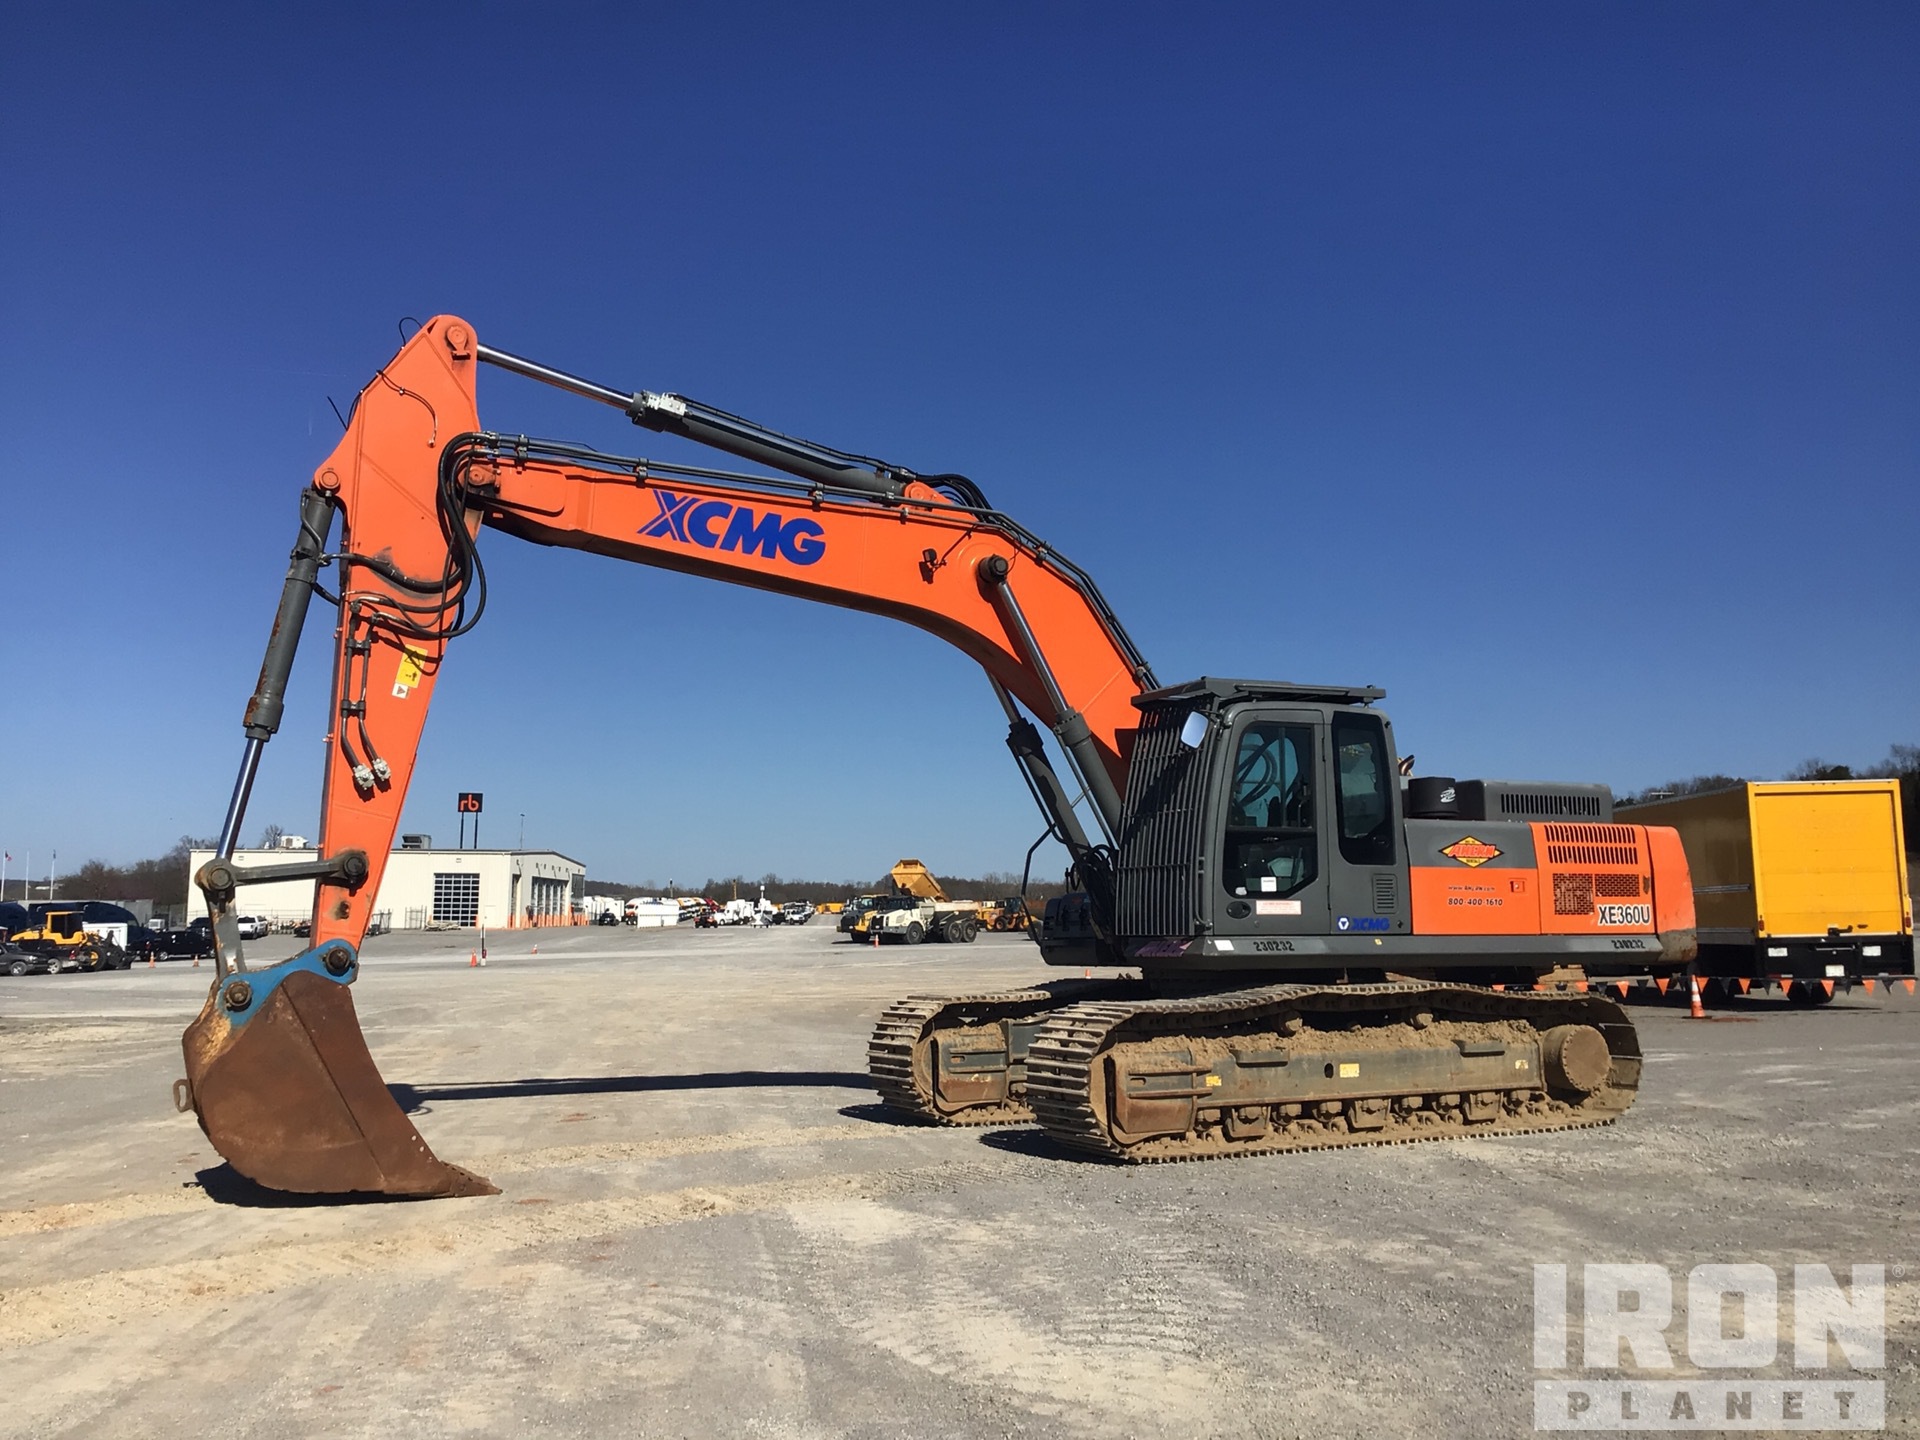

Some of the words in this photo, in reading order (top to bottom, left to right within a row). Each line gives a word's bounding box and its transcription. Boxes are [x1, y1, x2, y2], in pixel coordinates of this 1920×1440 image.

[637, 488, 826, 566] XCMG
[460, 794, 479, 811] rb
[1598, 905, 1651, 925] XE360U
[1350, 917, 1390, 931] XCMG
[1253, 940, 1295, 952] 230232
[1611, 939, 1646, 949] 230232
